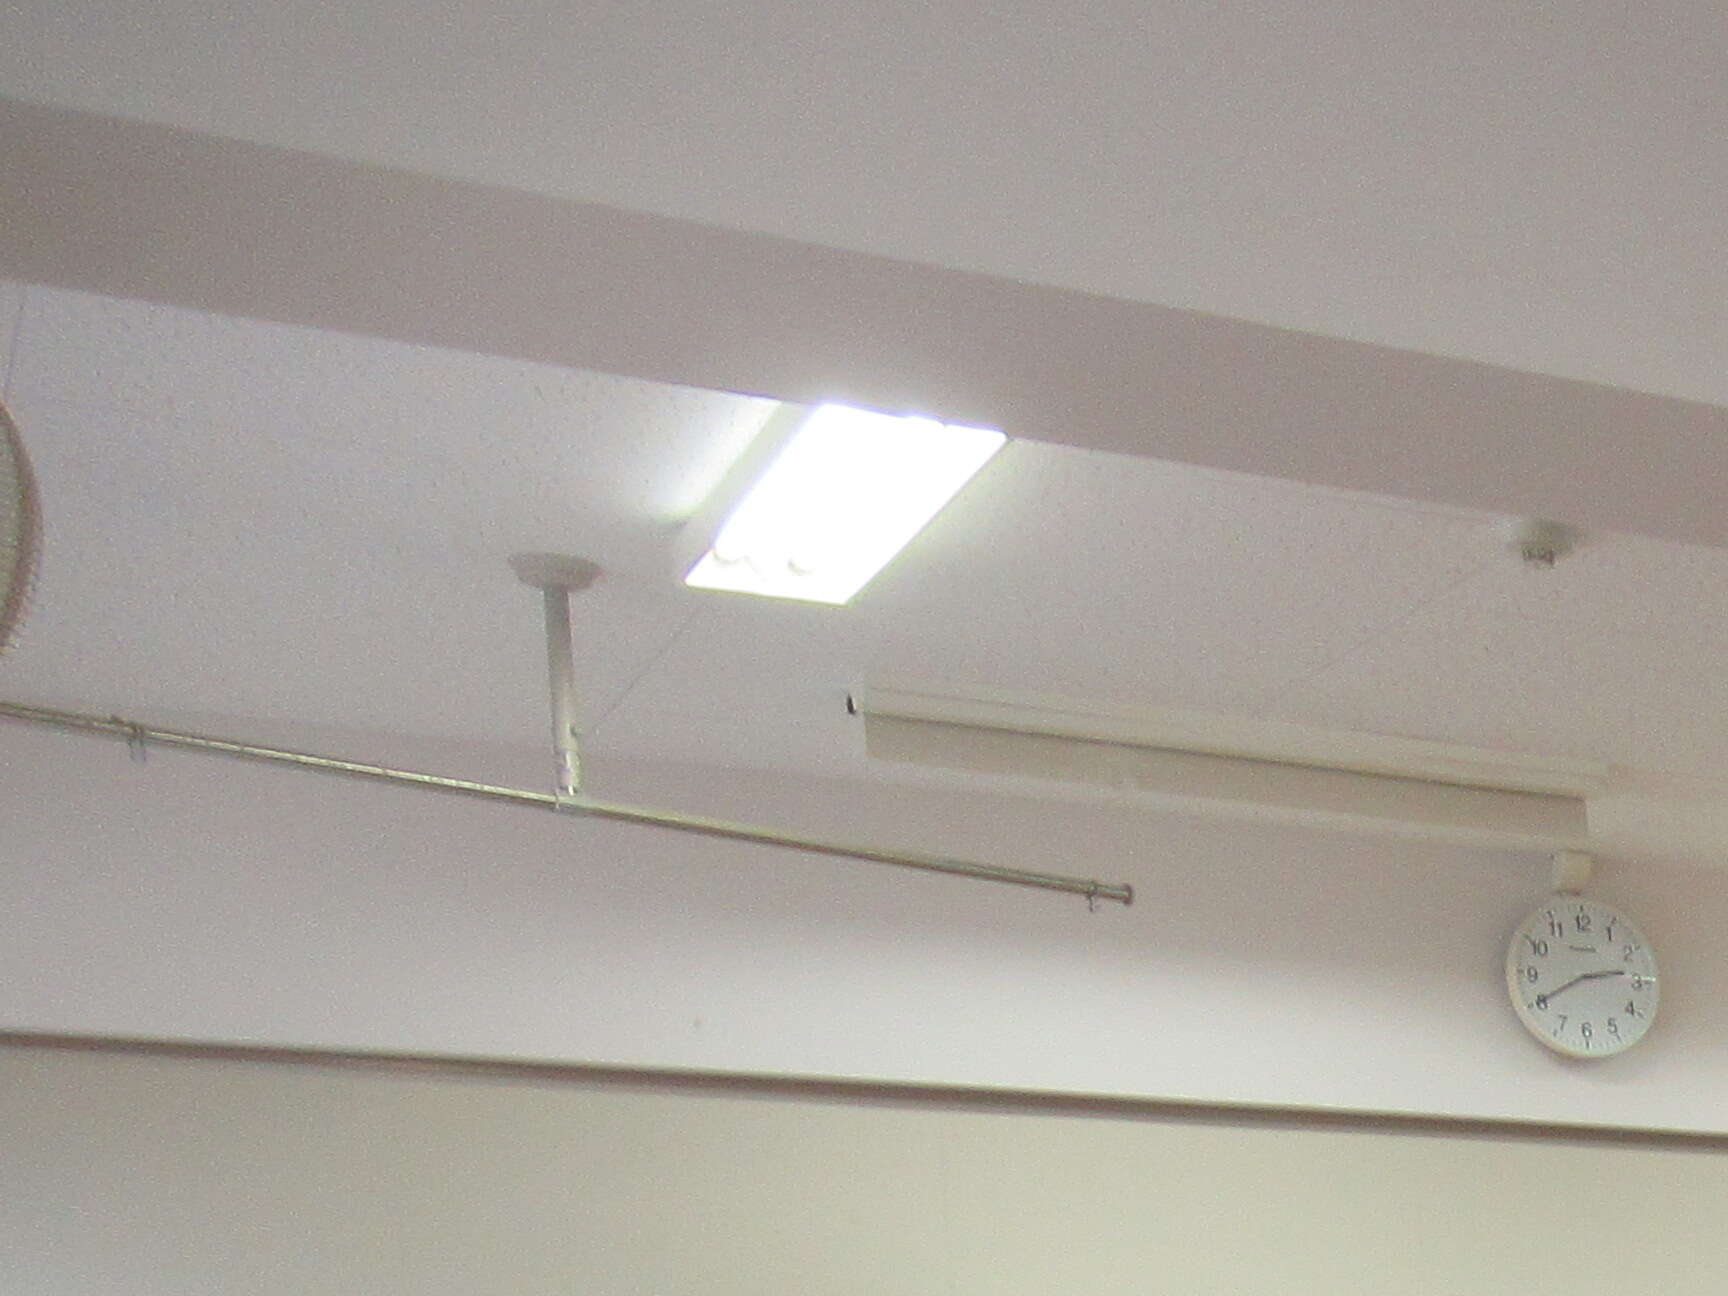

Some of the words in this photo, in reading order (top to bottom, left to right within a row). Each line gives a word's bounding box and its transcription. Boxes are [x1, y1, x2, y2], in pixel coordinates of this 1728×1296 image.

[1550, 921, 1562, 938] 11
[1575, 914, 1591, 932] 12
[1606, 926, 1613, 941] 1
[1533, 940, 1548, 956] 10
[1623, 945, 1633, 962] 2
[1527, 966, 1538, 983] 9
[1624, 1000, 1635, 1017] 4
[1558, 1015, 1568, 1031] 7
[1581, 1022, 1592, 1038] 6
[1607, 1017, 1618, 1034] 5
